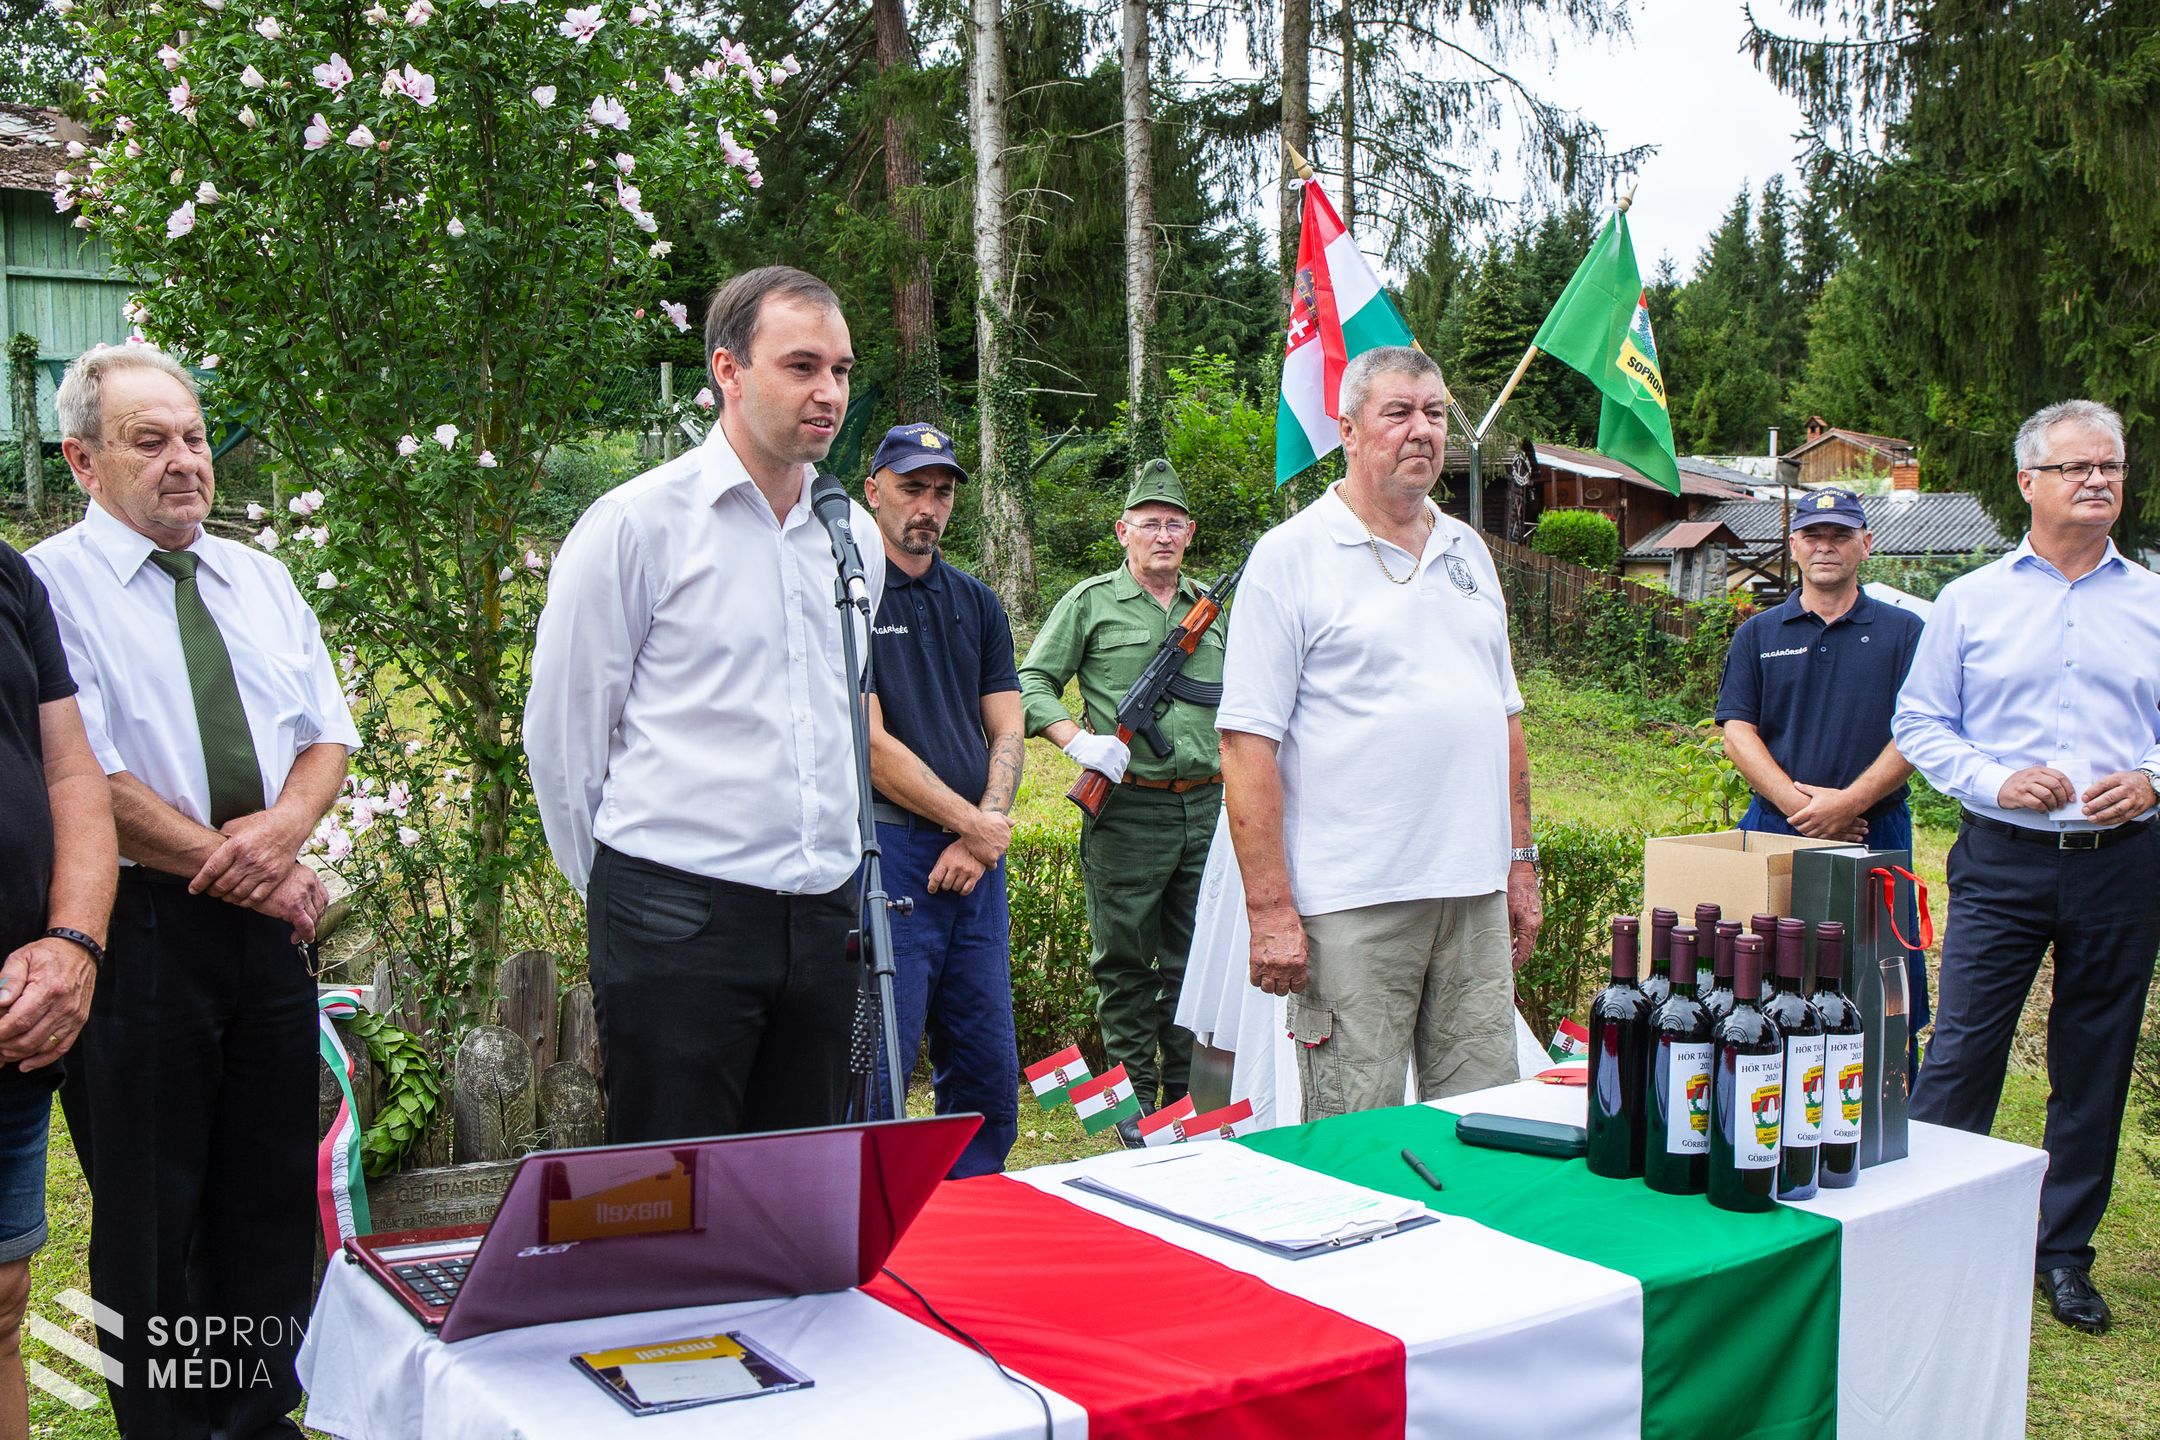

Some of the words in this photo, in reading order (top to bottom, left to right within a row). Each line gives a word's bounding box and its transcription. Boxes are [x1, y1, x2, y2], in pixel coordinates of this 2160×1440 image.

[1627, 356, 1663, 397] SOPRON
[517, 1241, 581, 1258] acer
[635, 1341, 717, 1360] maxell
